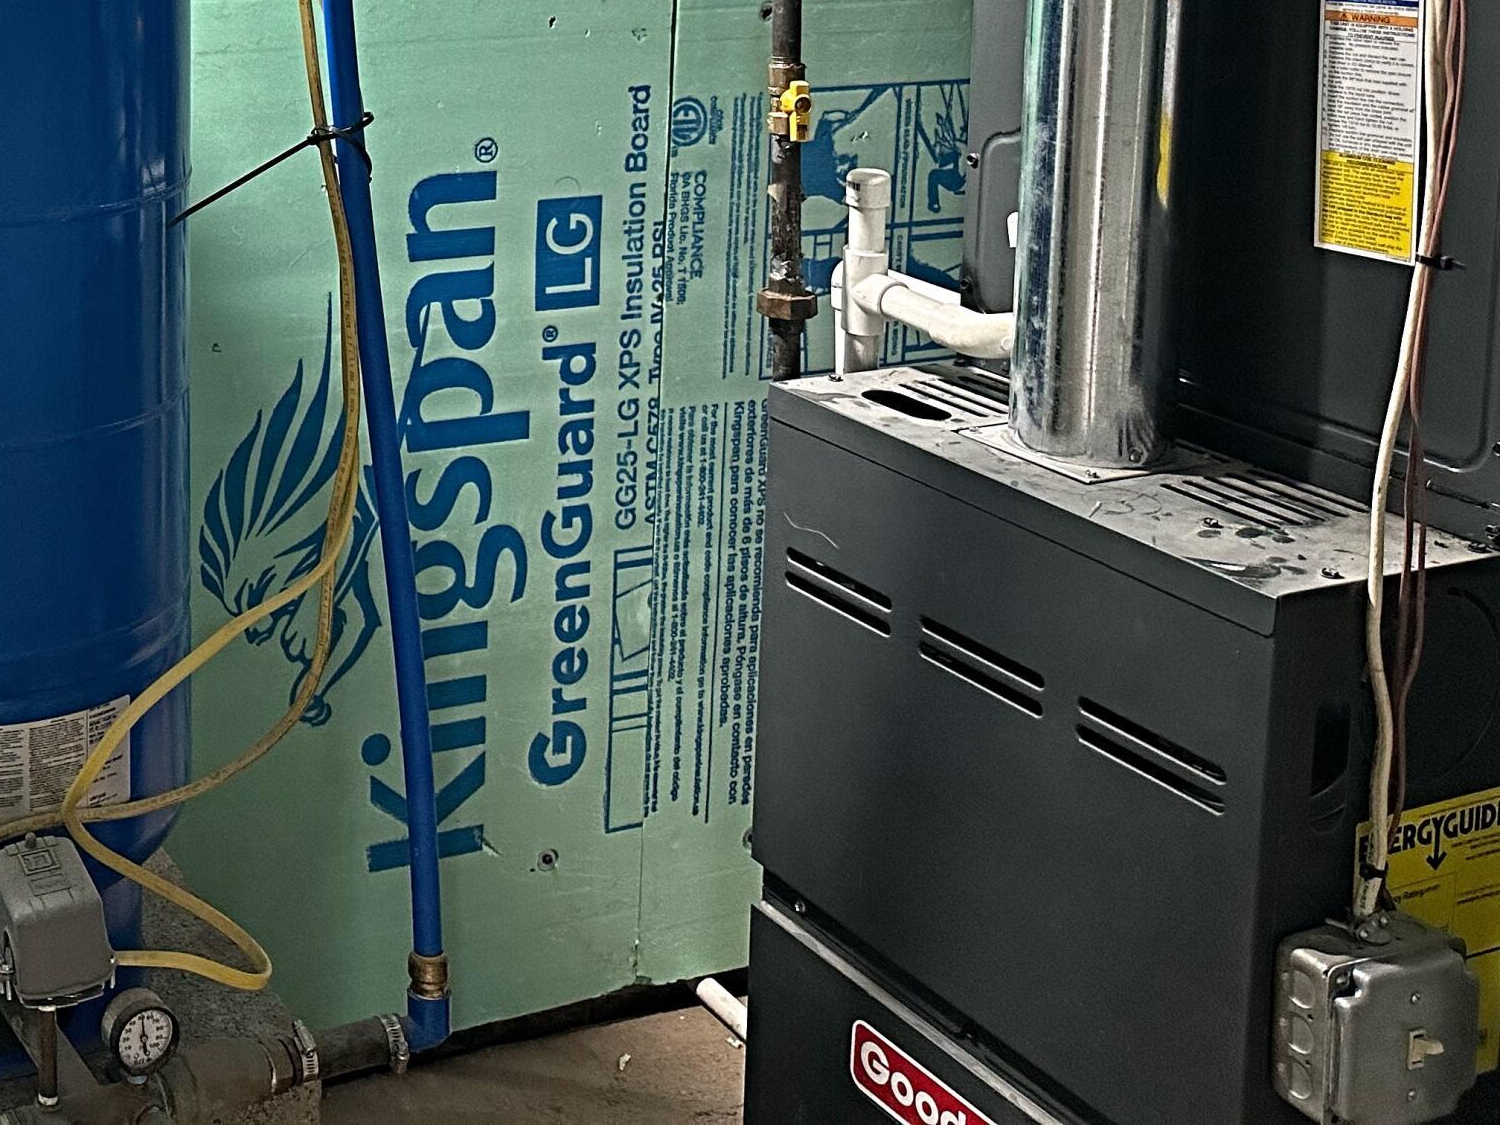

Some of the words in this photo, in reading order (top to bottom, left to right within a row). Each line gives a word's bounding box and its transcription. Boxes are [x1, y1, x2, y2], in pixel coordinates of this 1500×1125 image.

[1352, 14, 1390, 23] WARNING
[625, 85, 651, 172] Board
[544, 212, 593, 293] LG
[620, 182, 647, 320] Insulation
[690, 171, 707, 279] COMPLIANCE
[618, 329, 641, 389] XPS
[615, 398, 640, 530] GG25-LG
[729, 401, 744, 462] Kingspan
[1359, 801, 1500, 863] ERGYGUID
